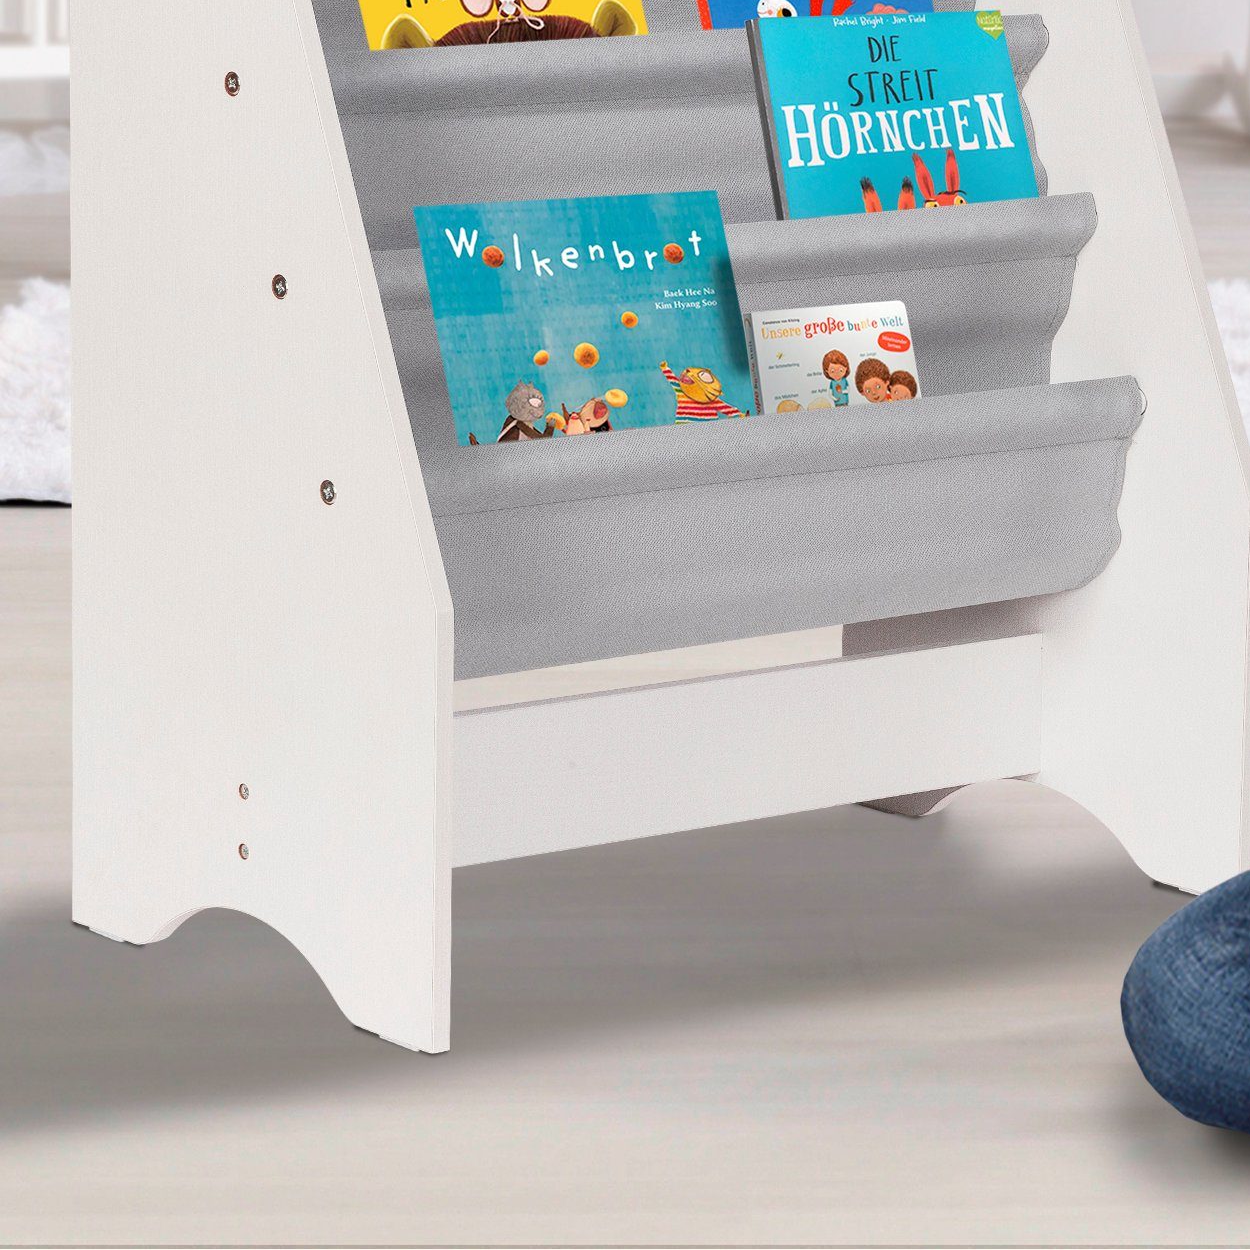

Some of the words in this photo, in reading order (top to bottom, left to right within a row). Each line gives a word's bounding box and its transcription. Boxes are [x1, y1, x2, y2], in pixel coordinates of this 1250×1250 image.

[833, 16, 858, 27] Rachel
[860, 15, 884, 29] Bright
[892, 14, 907, 25] Jim
[908, 14, 926, 24] Field
[867, 35, 902, 63] DIE
[848, 68, 938, 107] STREIT
[781, 92, 1015, 168] HÖRNCHEN
[655, 302, 673, 310] Kim
[674, 300, 701, 310] Hyang
[702, 298, 718, 307] Soo
[685, 288, 702, 297] Hee
[703, 287, 716, 296] Na
[761, 326, 801, 340] Unsere
[804, 317, 846, 339] große
[847, 318, 878, 332] bunte
[880, 315, 904, 328] Welt
